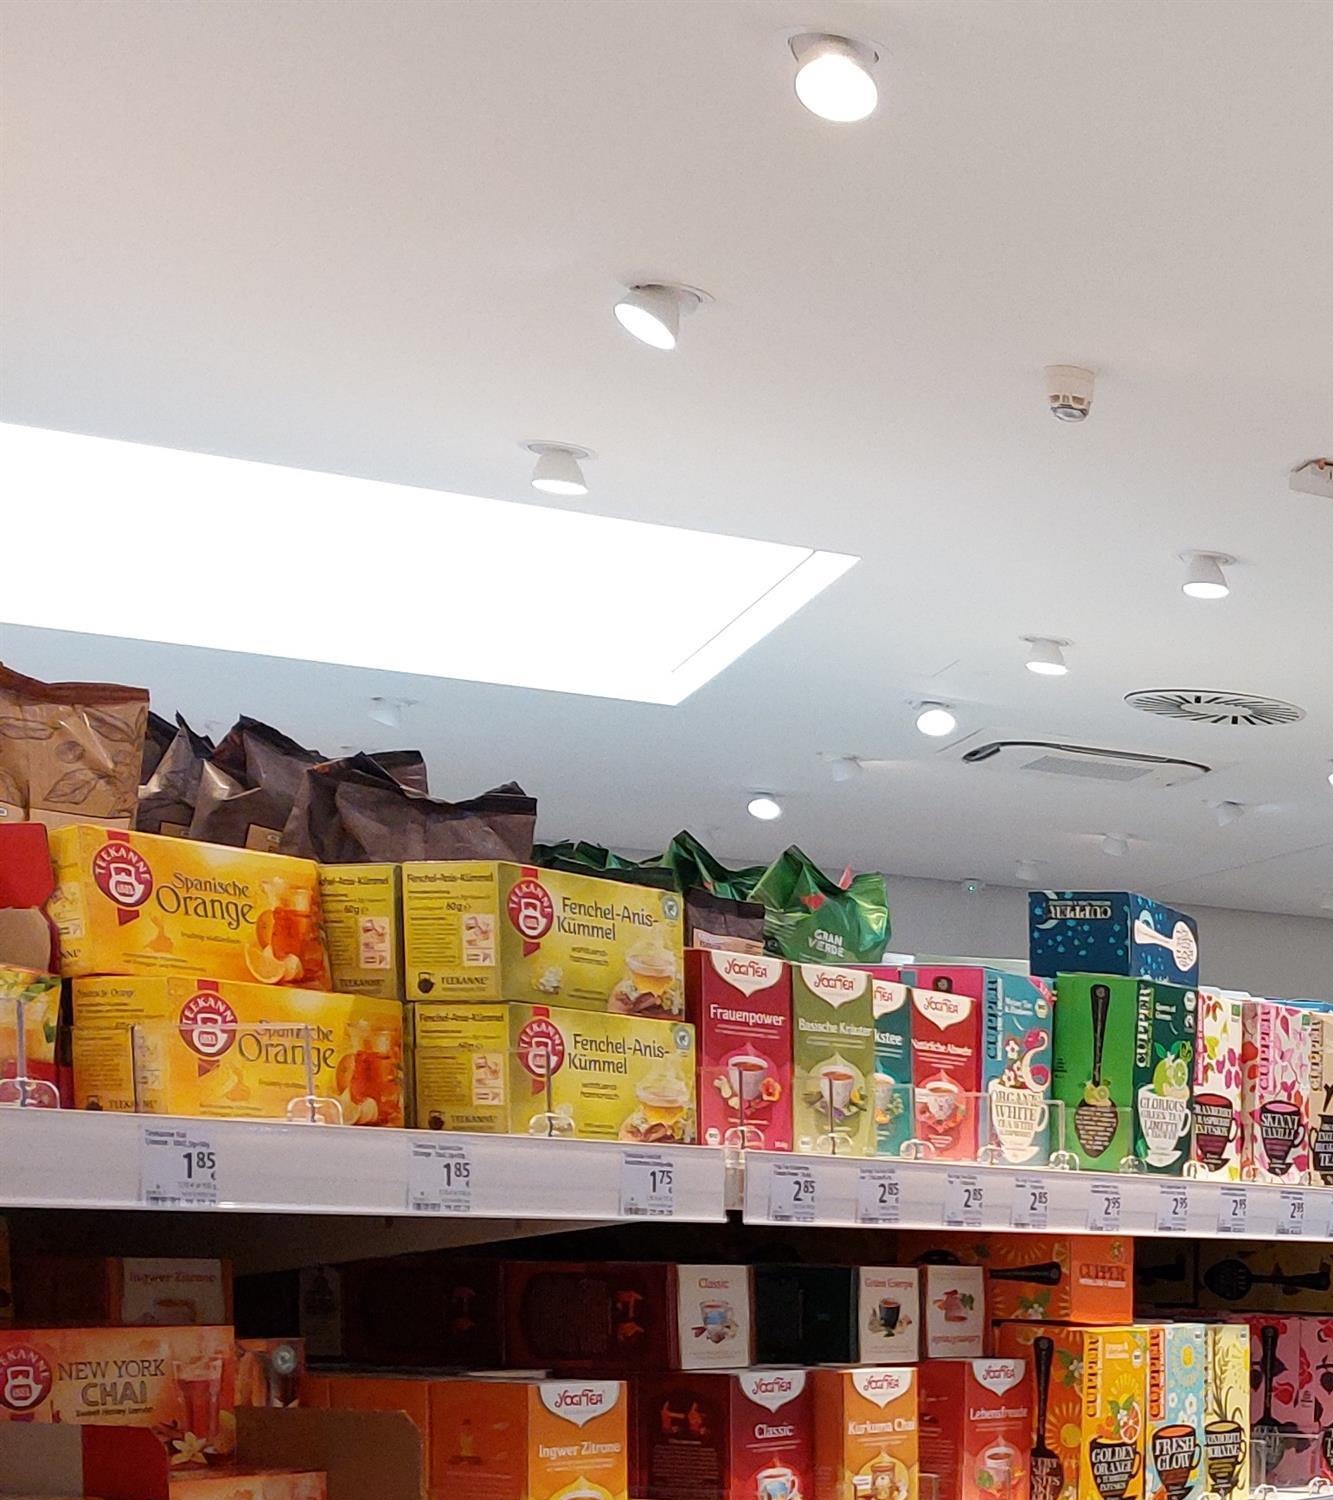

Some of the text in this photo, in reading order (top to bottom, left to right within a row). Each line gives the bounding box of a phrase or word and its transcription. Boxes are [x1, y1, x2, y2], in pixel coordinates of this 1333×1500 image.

[93, 843, 153, 884] TEEKANNE
[173, 872, 251, 899] Spanische
[156, 886, 256, 931] Orange
[508, 881, 553, 914] TEEKANNE
[561, 896, 659, 927] Fenchel-Anis-
[557, 914, 617, 942] Kümmel
[814, 928, 844, 944] GRAN
[807, 935, 846, 958] VERDE
[709, 1004, 785, 1027] Frauenpower
[573, 1033, 671, 1060] Fenchel-Anis-
[874, 1026, 903, 1047] kstee
[238, 1033, 336, 1075] Orange
[568, 1052, 628, 1075] Kümmel
[995, 1106, 1037, 1122] WHITE
[58, 1358, 166, 1381] NEW YORK
[81, 1379, 148, 1408] CHAI
[538, 1443, 580, 1460] Ingwer
[1091, 1445, 1135, 1463] GOLDEN
[1154, 1436, 1195, 1456] FRESH
[1157, 1452, 1191, 1471] GLOW
